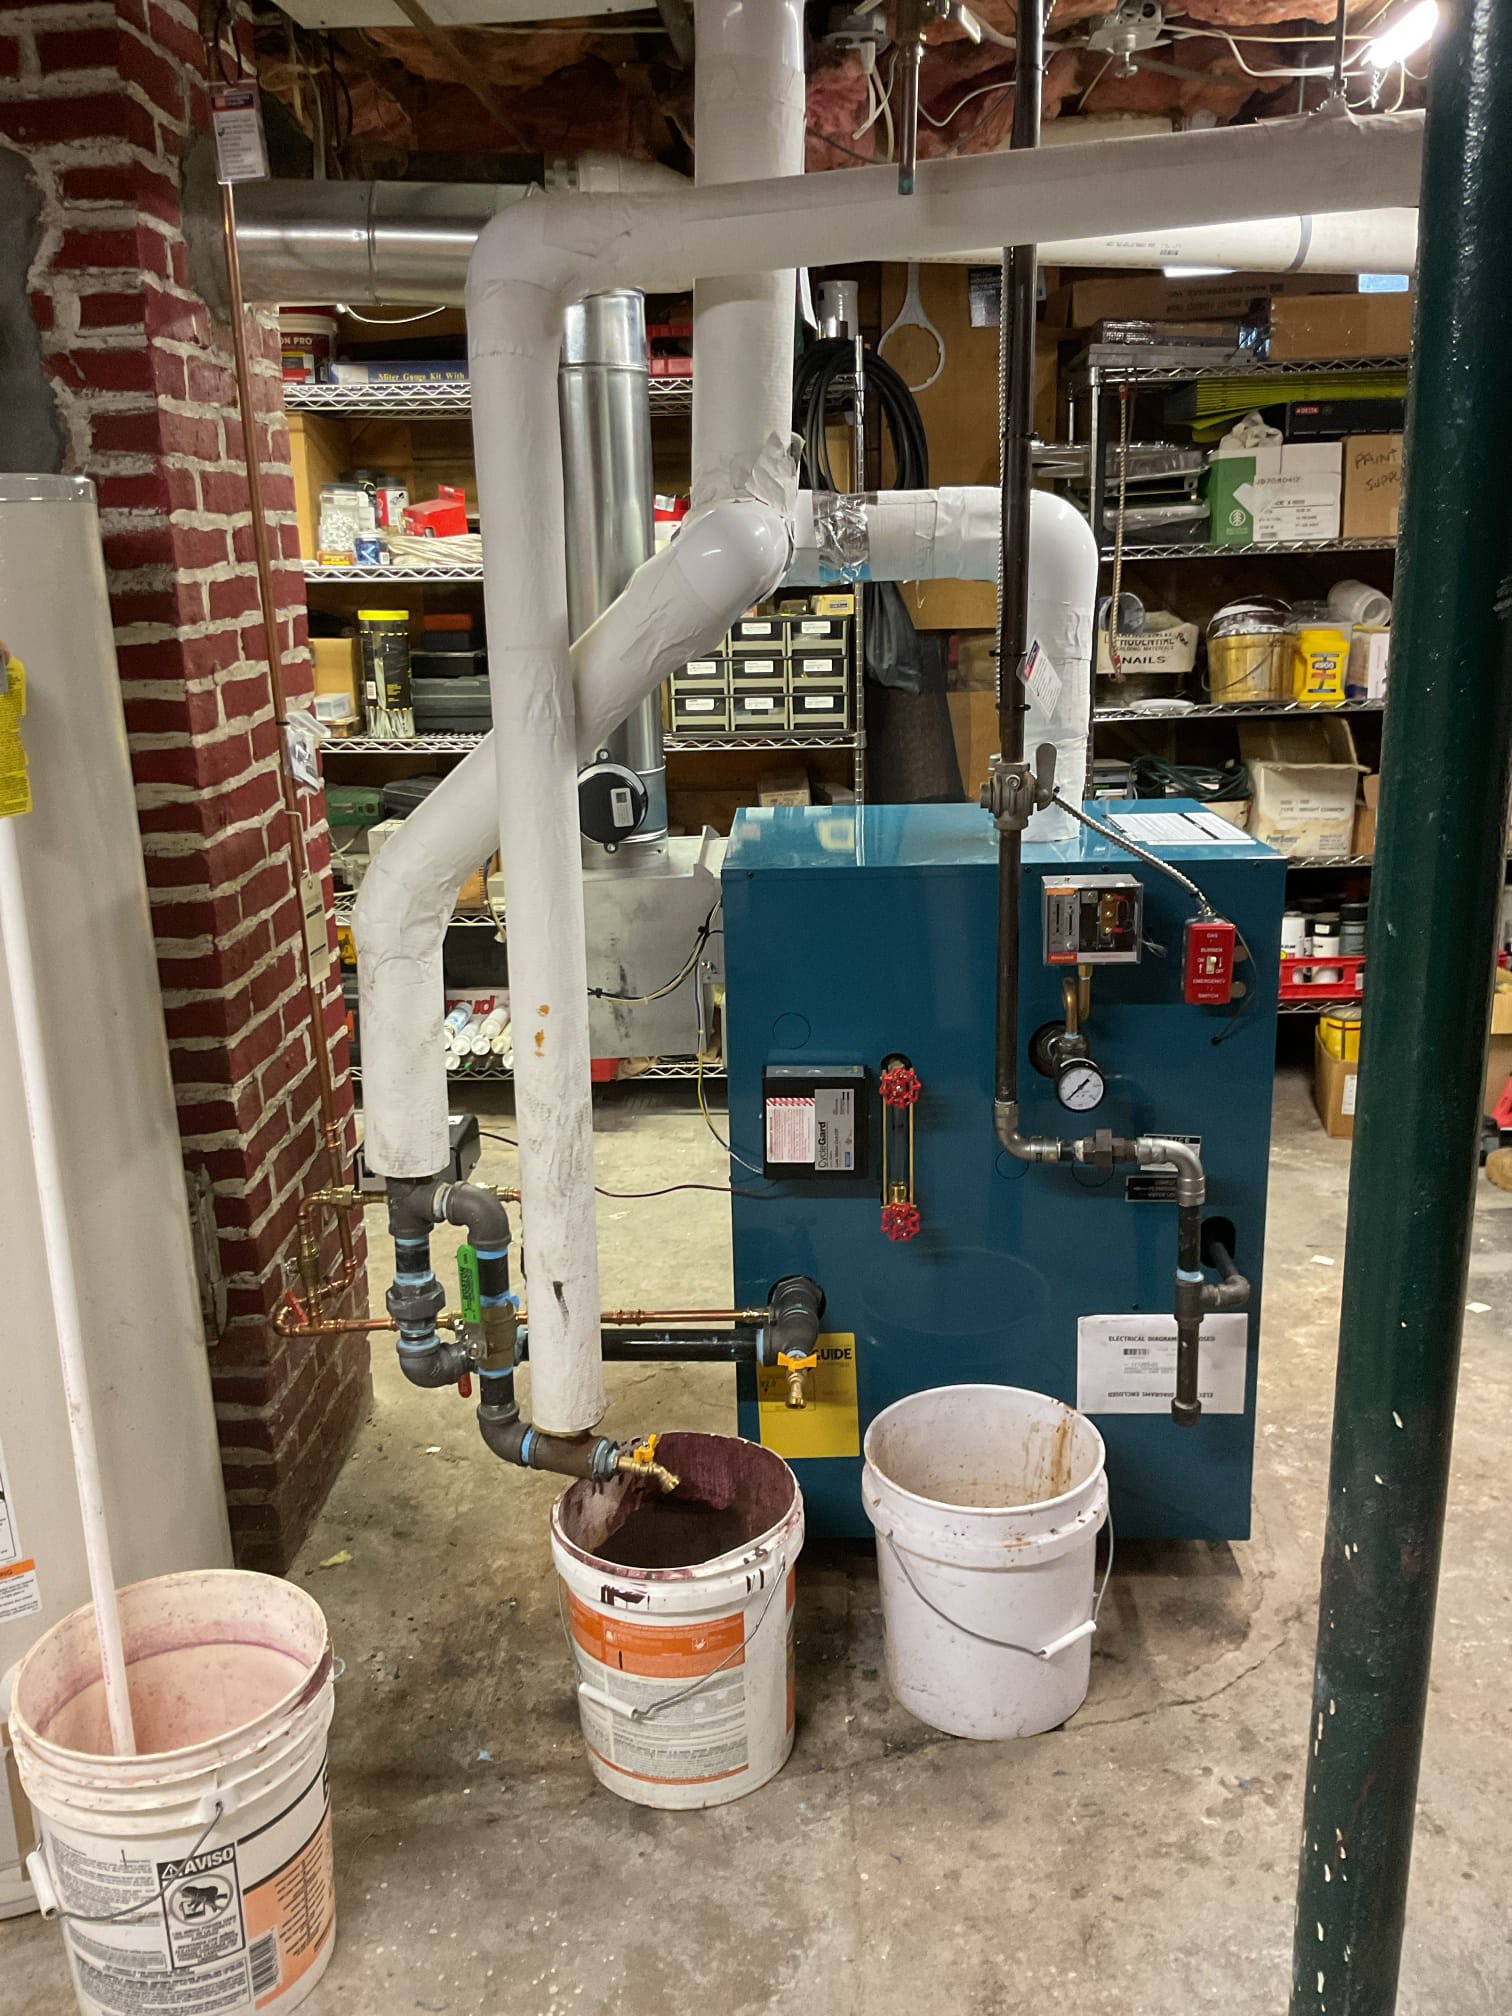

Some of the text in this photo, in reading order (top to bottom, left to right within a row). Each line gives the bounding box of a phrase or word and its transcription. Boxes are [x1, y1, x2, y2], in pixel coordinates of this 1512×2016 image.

[293, 337, 313, 345] PRO
[378, 371, 466, 382] Miter Gauge Kit With
[1354, 448, 1398, 470] PAINT
[1121, 656, 1167, 665] NAILS
[818, 1121, 828, 1169] CycleGard
[184, 1846, 235, 1875] AVISO
